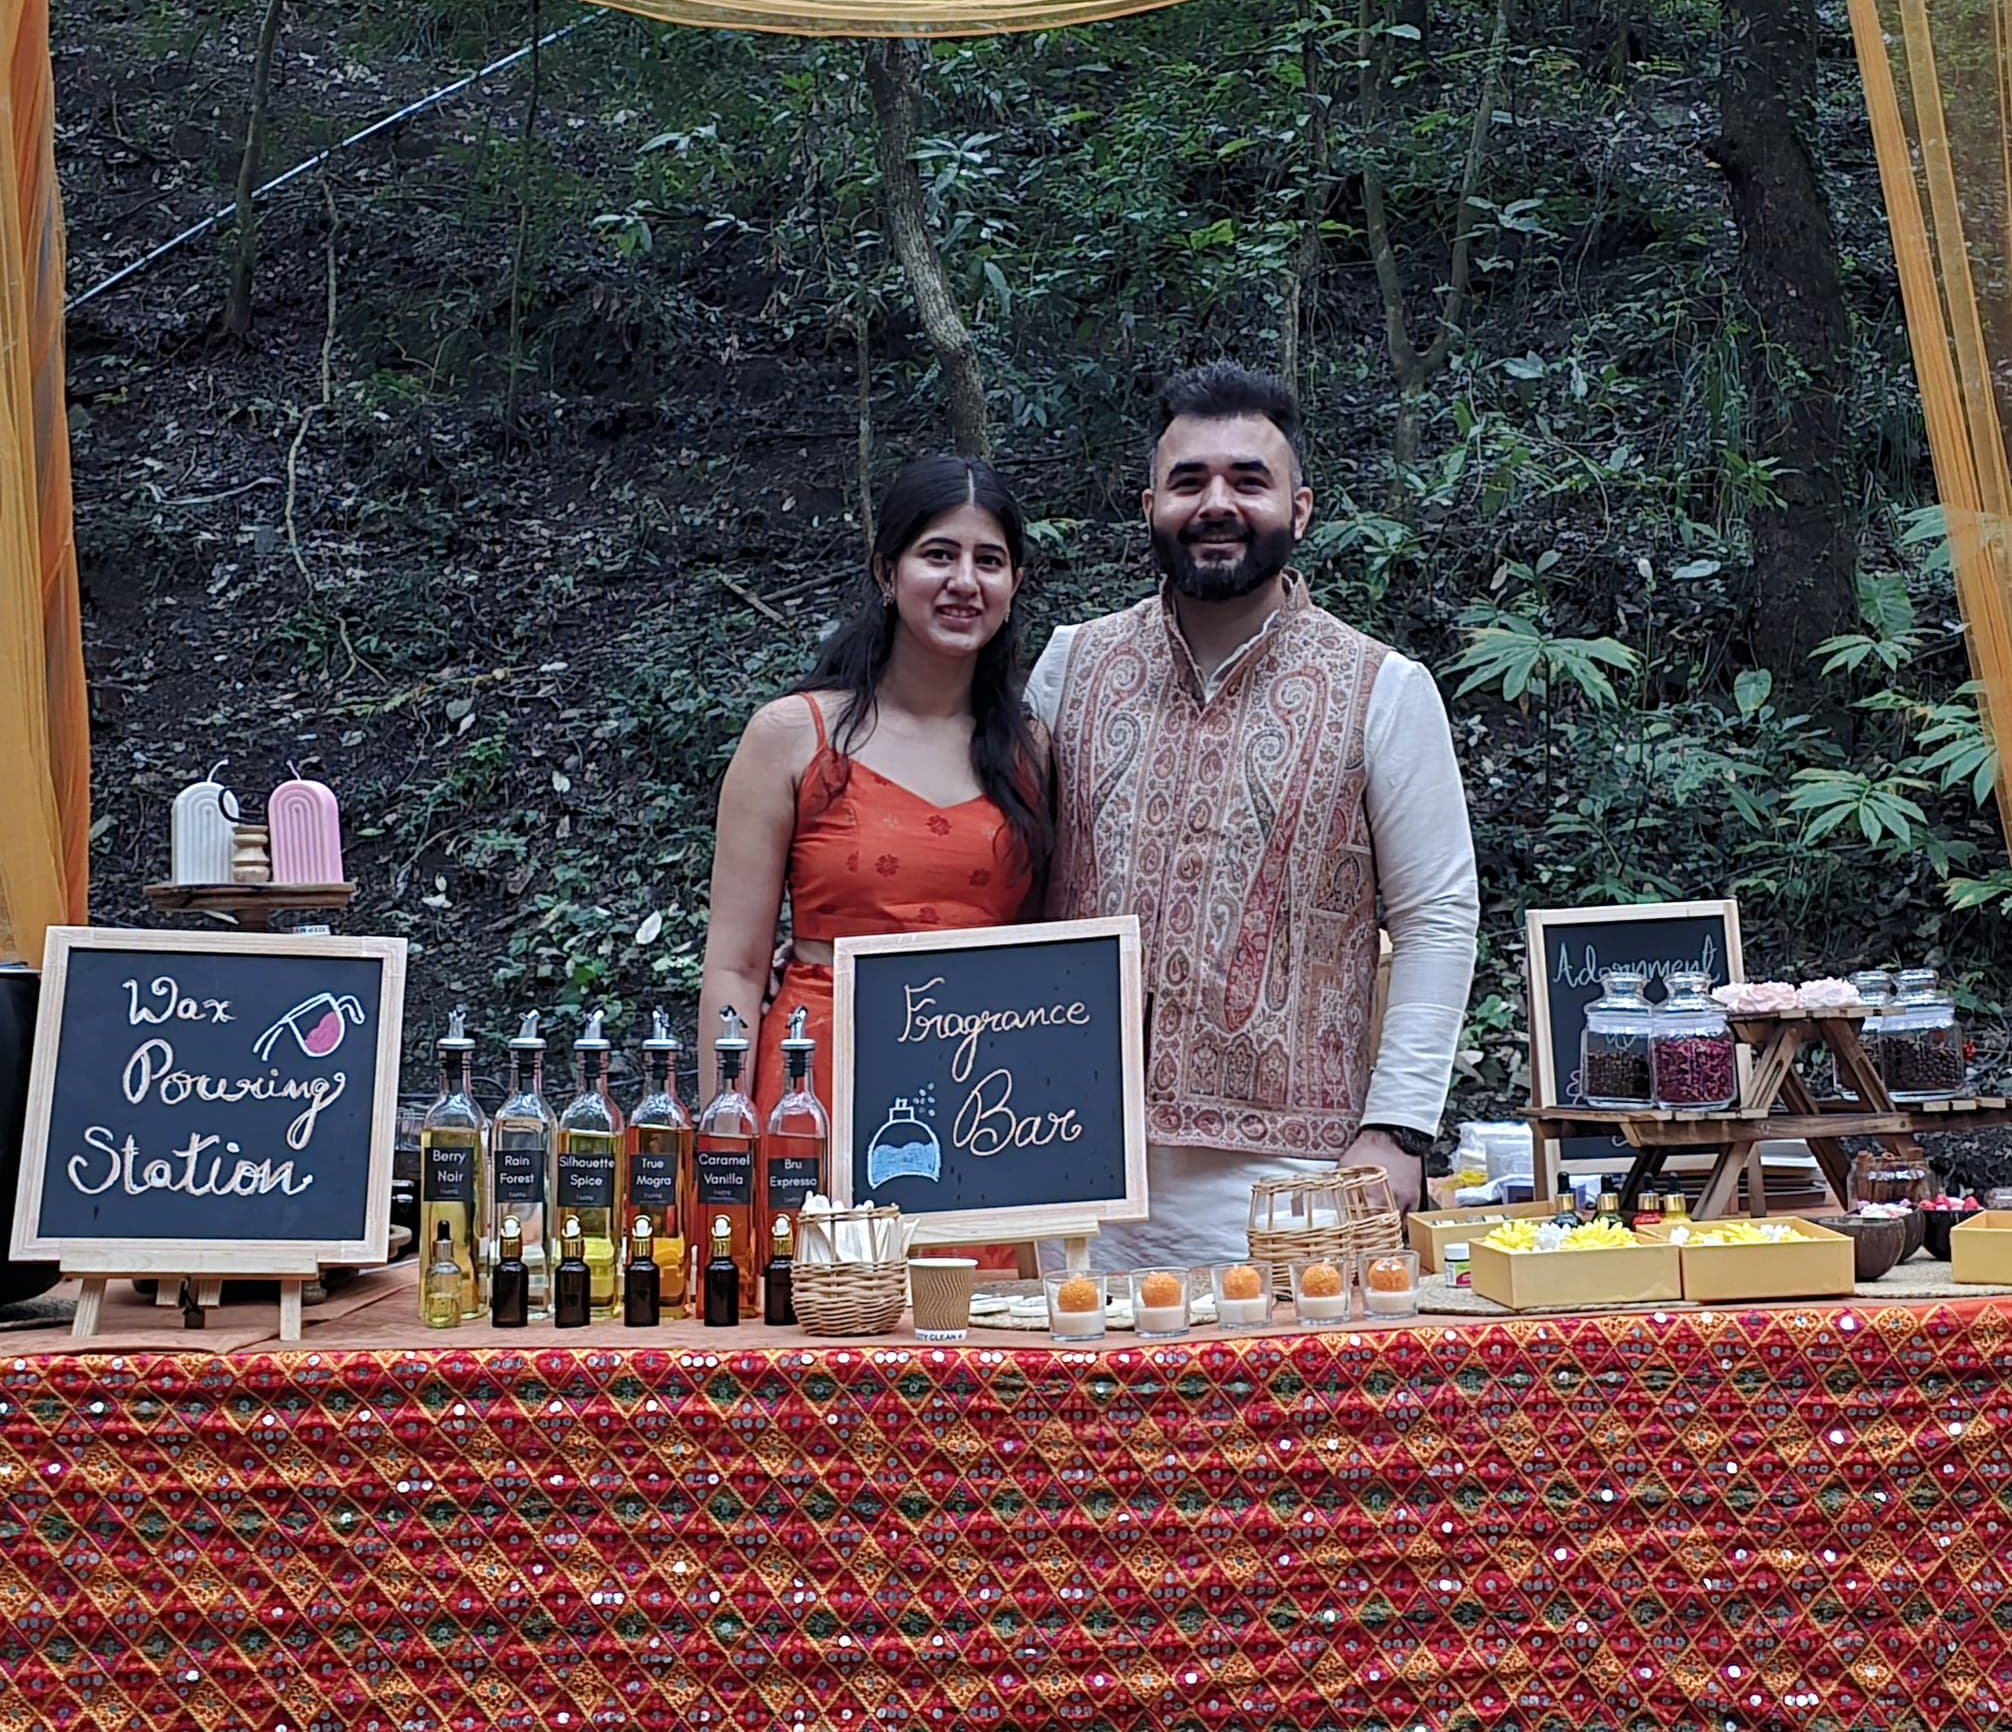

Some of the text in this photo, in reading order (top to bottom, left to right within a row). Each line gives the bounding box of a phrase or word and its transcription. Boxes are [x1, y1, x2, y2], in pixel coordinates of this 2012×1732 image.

[123, 977, 235, 1024] Wax
[898, 977, 1089, 1081] Fragrance
[123, 1039, 346, 1149] Pouring
[953, 1069, 1082, 1156] Bar
[67, 1126, 313, 1195] Station
[432, 1149, 466, 1165] Berry
[504, 1155, 530, 1167] Rain
[559, 1155, 616, 1169] Silhouette
[641, 1158, 665, 1169] True
[698, 1153, 751, 1166] Caramel
[784, 1158, 803, 1170] Bru
[437, 1170, 464, 1183] Noir
[499, 1172, 535, 1184] Forest
[570, 1174, 604, 1188] Spice
[636, 1175, 672, 1188] Mogra
[703, 1173, 744, 1185] Vanilla
[769, 1176, 818, 1189] Expresso
